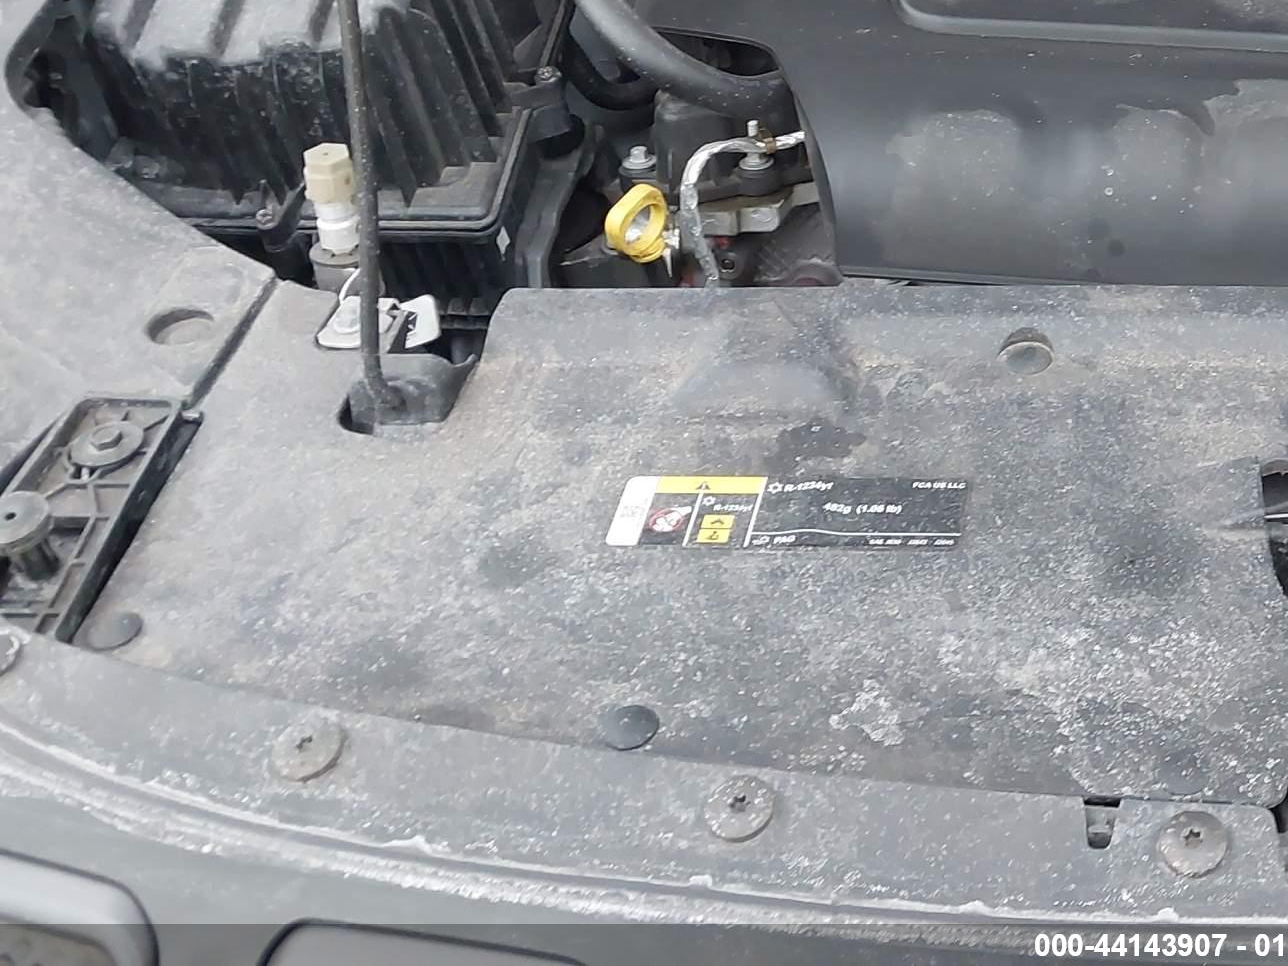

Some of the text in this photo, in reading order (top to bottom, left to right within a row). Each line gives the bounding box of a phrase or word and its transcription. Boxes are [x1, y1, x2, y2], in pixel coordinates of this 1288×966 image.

[912, 481, 967, 489] FCA US LLC
[885, 504, 903, 515] lb)
